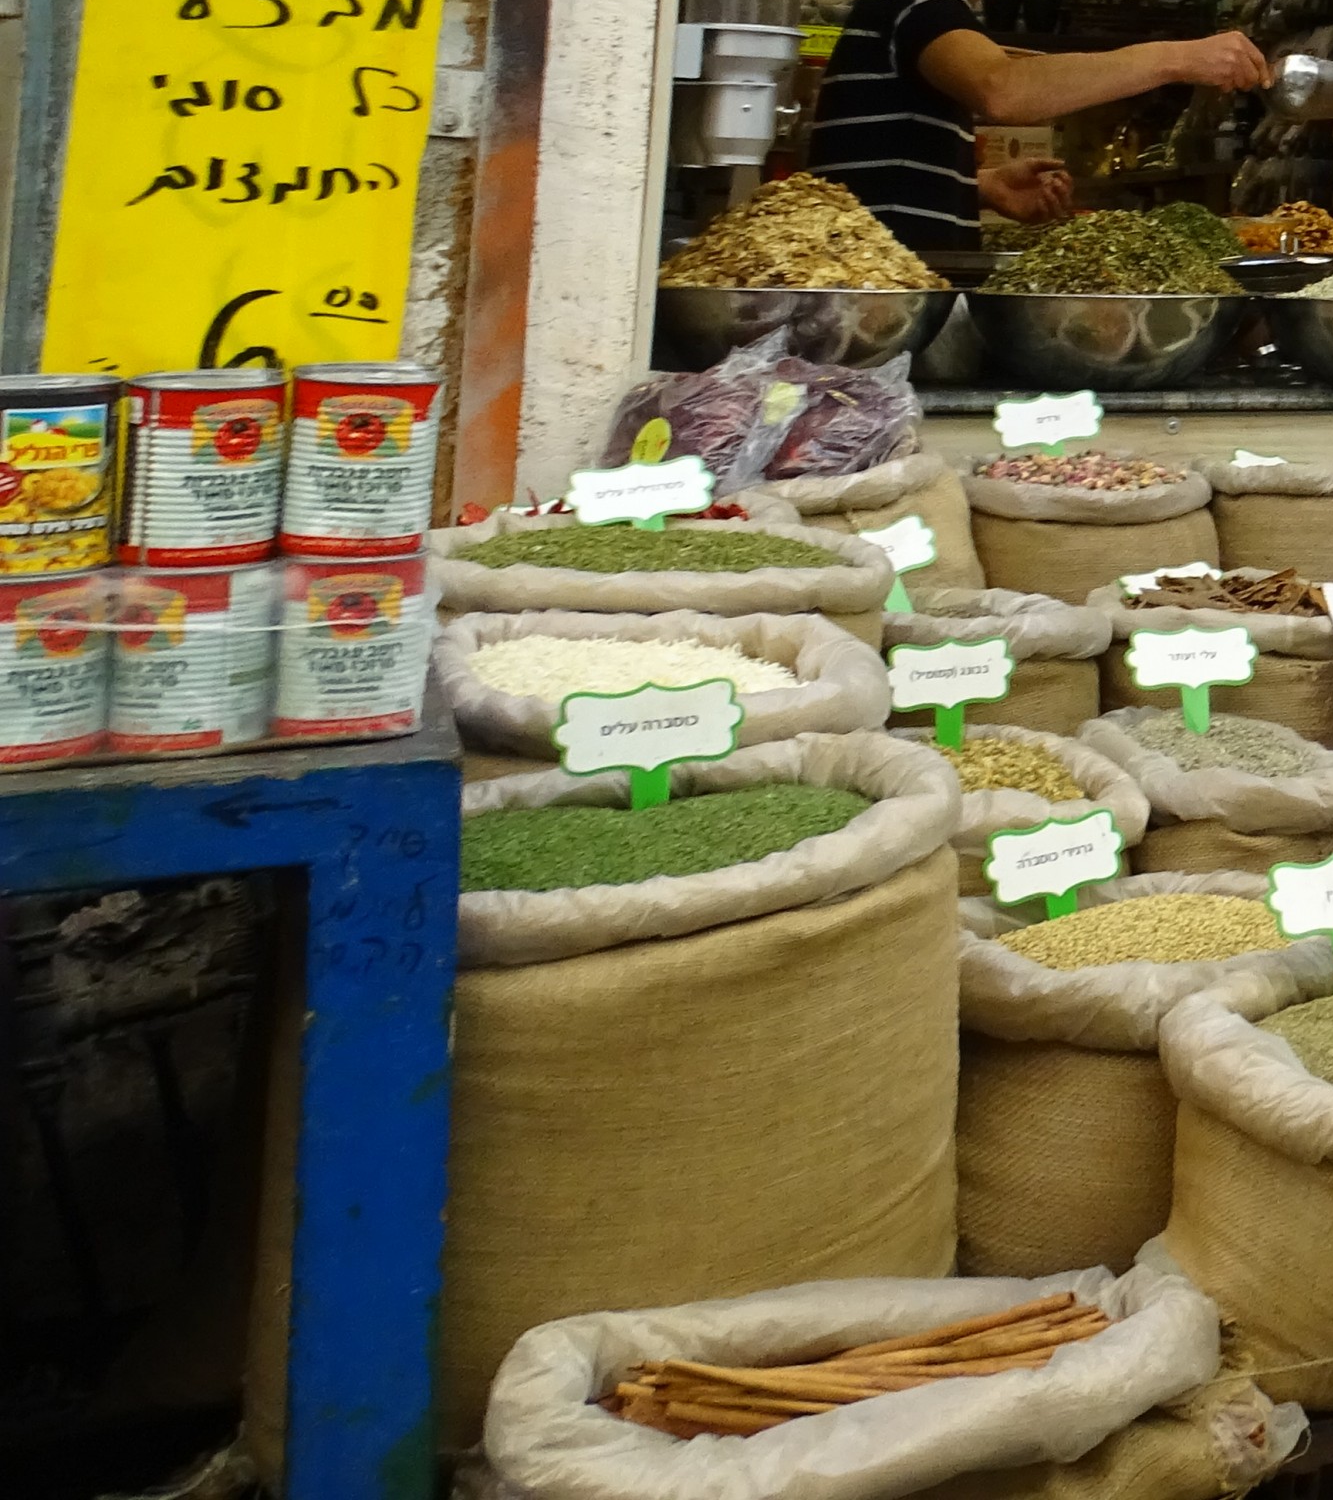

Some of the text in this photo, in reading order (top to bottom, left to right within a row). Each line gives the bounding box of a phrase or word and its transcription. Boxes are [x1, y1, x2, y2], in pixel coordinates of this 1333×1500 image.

[150, 66, 422, 118] כל סוגי
[599, 713, 701, 739] כוסברה עלים
[1016, 851, 1059, 870] כוסברה
